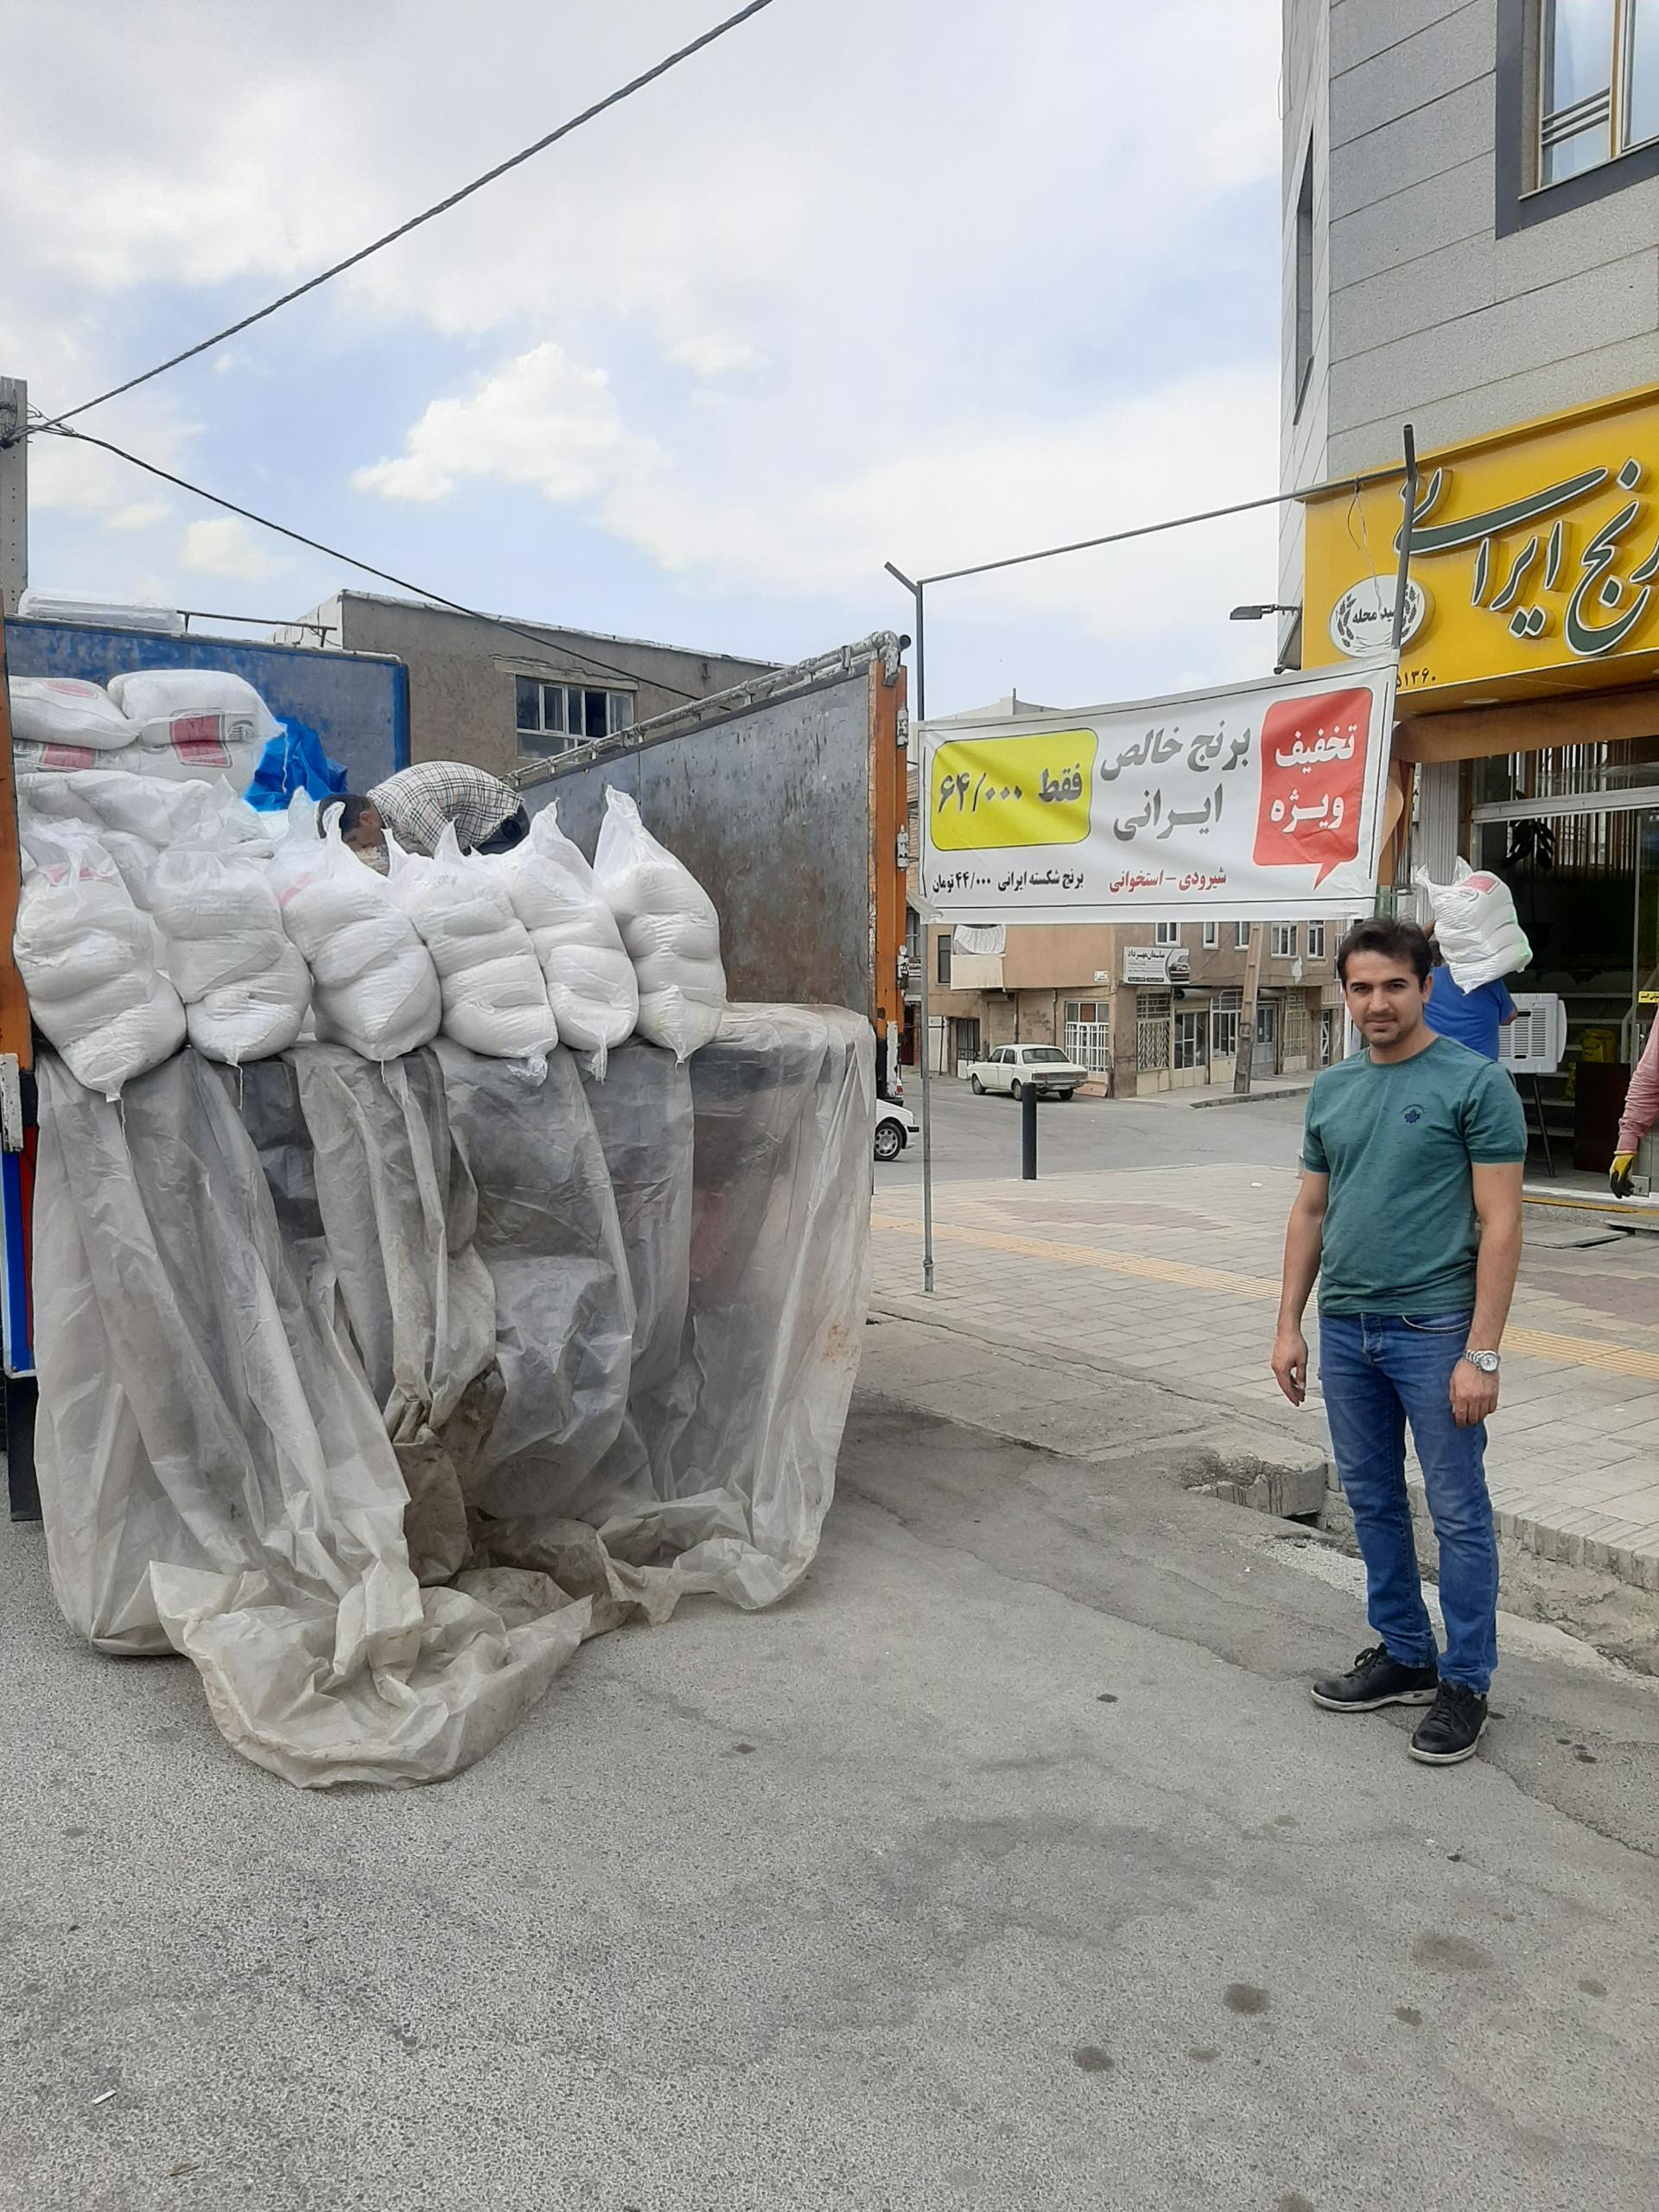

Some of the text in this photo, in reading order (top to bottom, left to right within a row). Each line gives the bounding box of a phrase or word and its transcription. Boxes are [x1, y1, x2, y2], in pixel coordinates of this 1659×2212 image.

[1565, 456, 1659, 656] رنج
[1352, 607, 1395, 623] ید محله
[1101, 720, 1250, 781] برنج خالص
[1275, 724, 1357, 774] تخفیف
[938, 763, 1083, 812] فقط ۶۴/۰۰۰
[1113, 782, 1223, 842] ایرانی
[1270, 788, 1344, 833] ویژه
[932, 874, 954, 893] تومان
[998, 870, 1027, 891] ایرانی
[1029, 869, 1060, 885] شکسته
[1062, 868, 1084, 889] برنج
[1109, 869, 1164, 893] استخوانی
[1179, 867, 1226, 891] شیرودی
